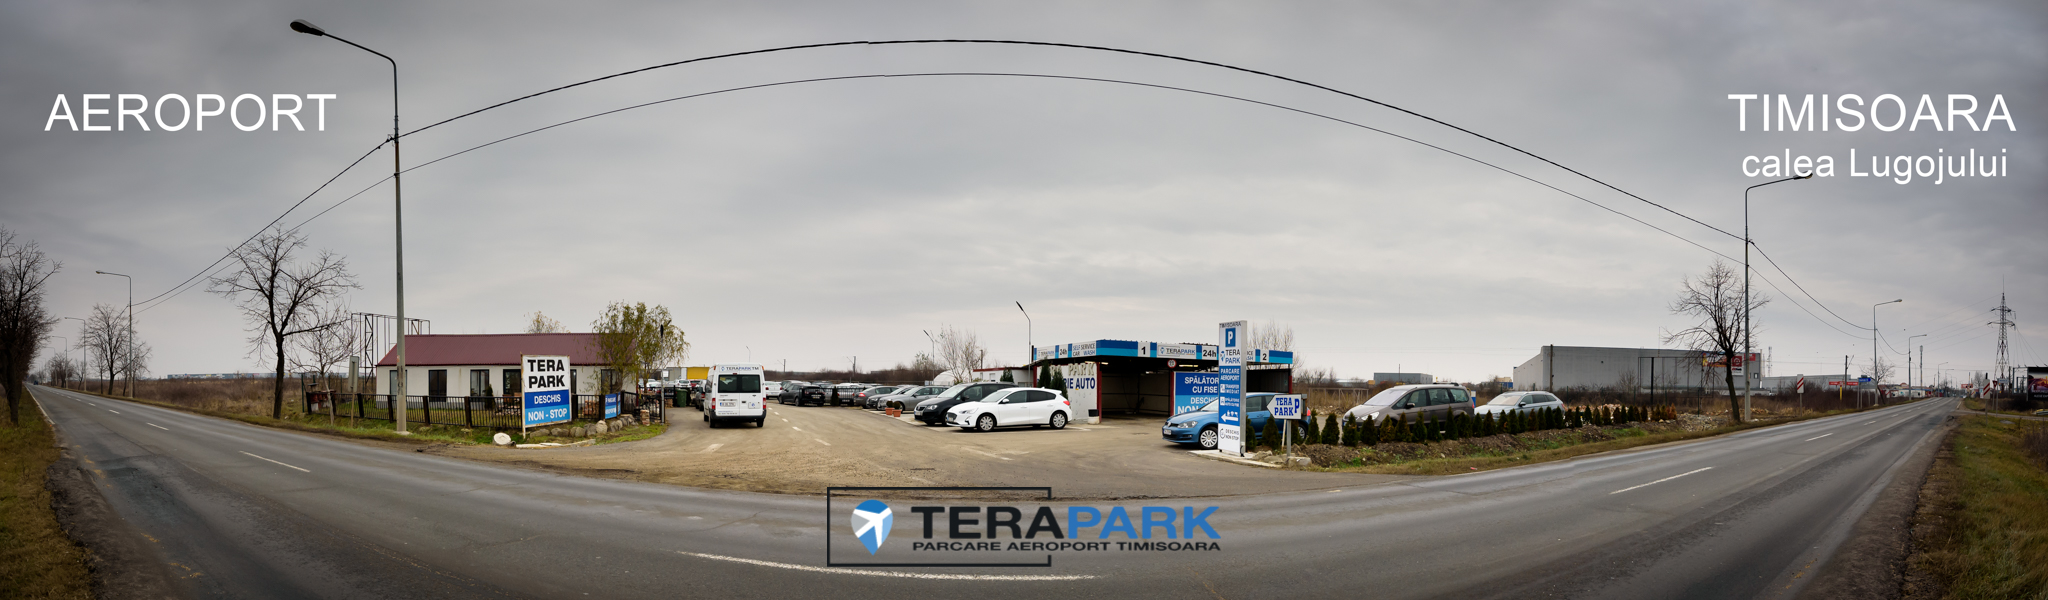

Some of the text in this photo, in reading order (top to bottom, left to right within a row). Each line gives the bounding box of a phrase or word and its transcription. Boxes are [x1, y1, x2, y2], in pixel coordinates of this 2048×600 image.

[1227, 331, 1233, 344] P
[1080, 342, 1096, 350] SERVICE
[1141, 346, 1146, 355] 1
[1059, 348, 1068, 356] 24h
[1165, 347, 1196, 355] TERAPARK
[1202, 349, 1217, 358] 24h
[1224, 357, 1241, 365] PARK
[1262, 353, 1268, 361] 2
[527, 359, 565, 372] TERA
[1068, 363, 1095, 376] PARK
[528, 374, 566, 389] PARK
[1075, 378, 1095, 389] AUTO
[1192, 386, 1218, 394] CU FISE
[534, 394, 562, 405] DESCHIS
[1275, 397, 1293, 406] TERA
[1294, 398, 1300, 414] P
[528, 411, 545, 422] NON
[549, 408, 568, 419] STOP
[1274, 407, 1294, 416] PARK
